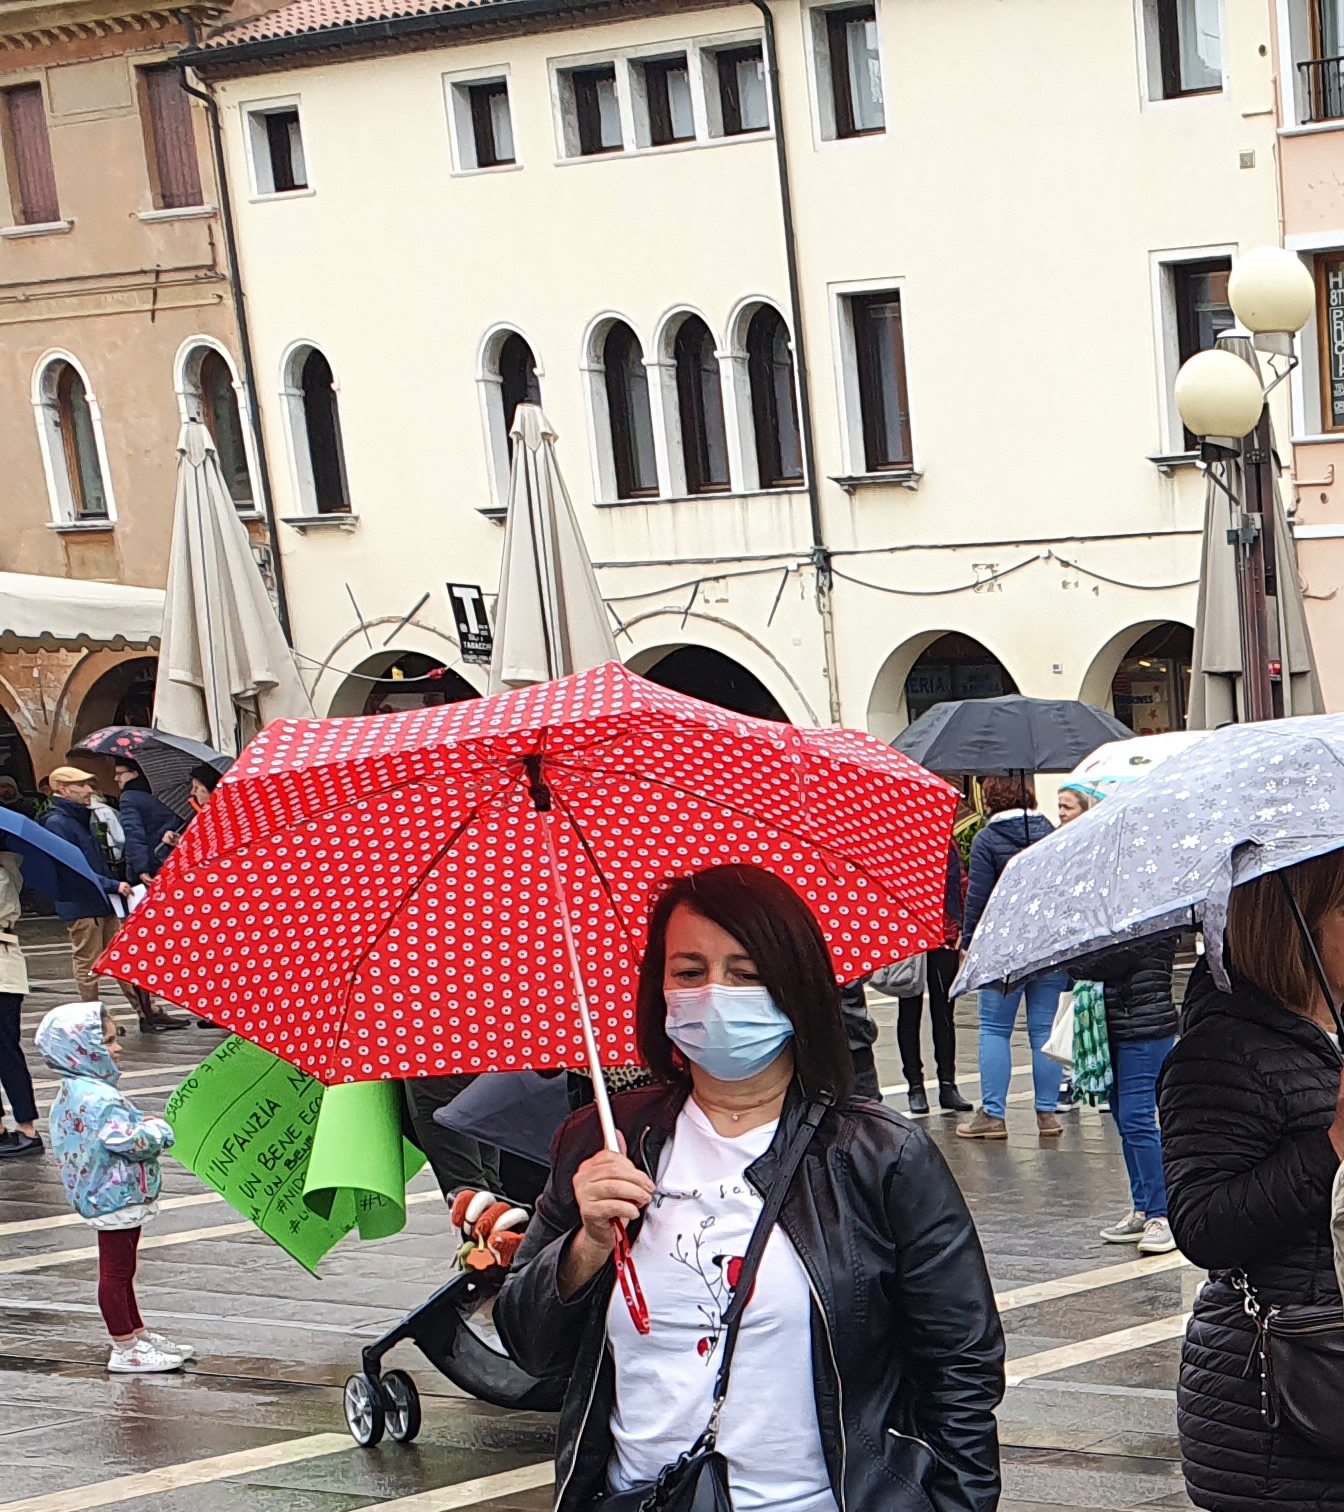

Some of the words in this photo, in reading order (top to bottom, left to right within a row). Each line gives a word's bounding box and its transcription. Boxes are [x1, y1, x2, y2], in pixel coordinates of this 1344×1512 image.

[452, 586, 480, 634] T
[205, 1098, 282, 1191] L'INFANZIA
[238, 1172, 263, 1200] UN
[257, 1123, 303, 1172] BENE
[263, 1175, 283, 1198] UN
